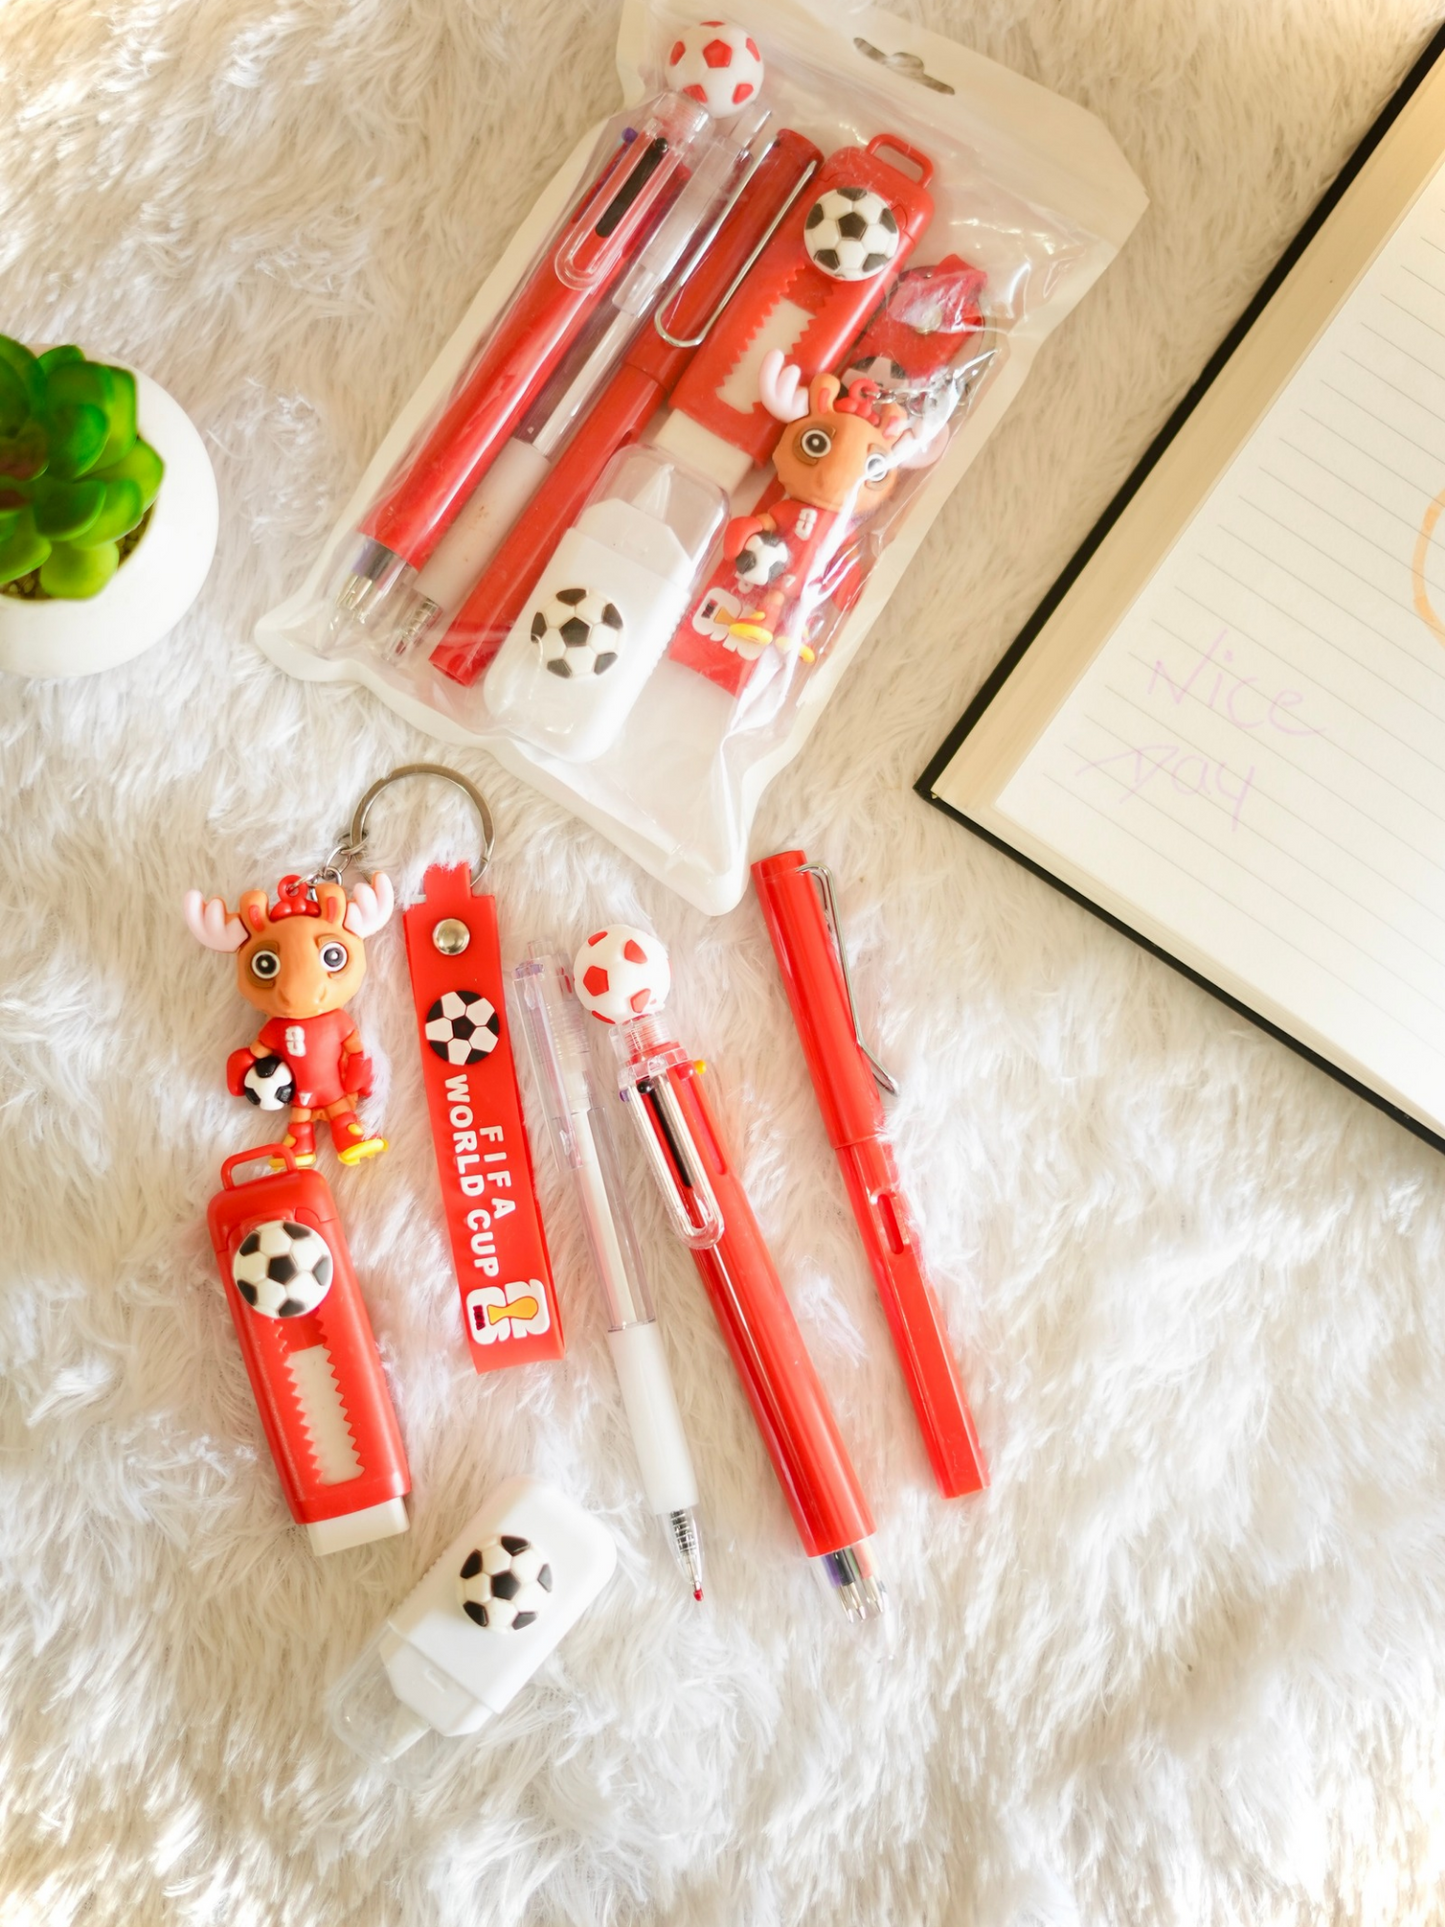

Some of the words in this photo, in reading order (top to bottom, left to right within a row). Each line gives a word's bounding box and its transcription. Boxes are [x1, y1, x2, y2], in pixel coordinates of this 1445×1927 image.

[1147, 627, 1328, 737] Nice
[445, 1074, 486, 1197] WORLD
[466, 1208, 501, 1277] CUP
[479, 1125, 517, 1220] FIFA
